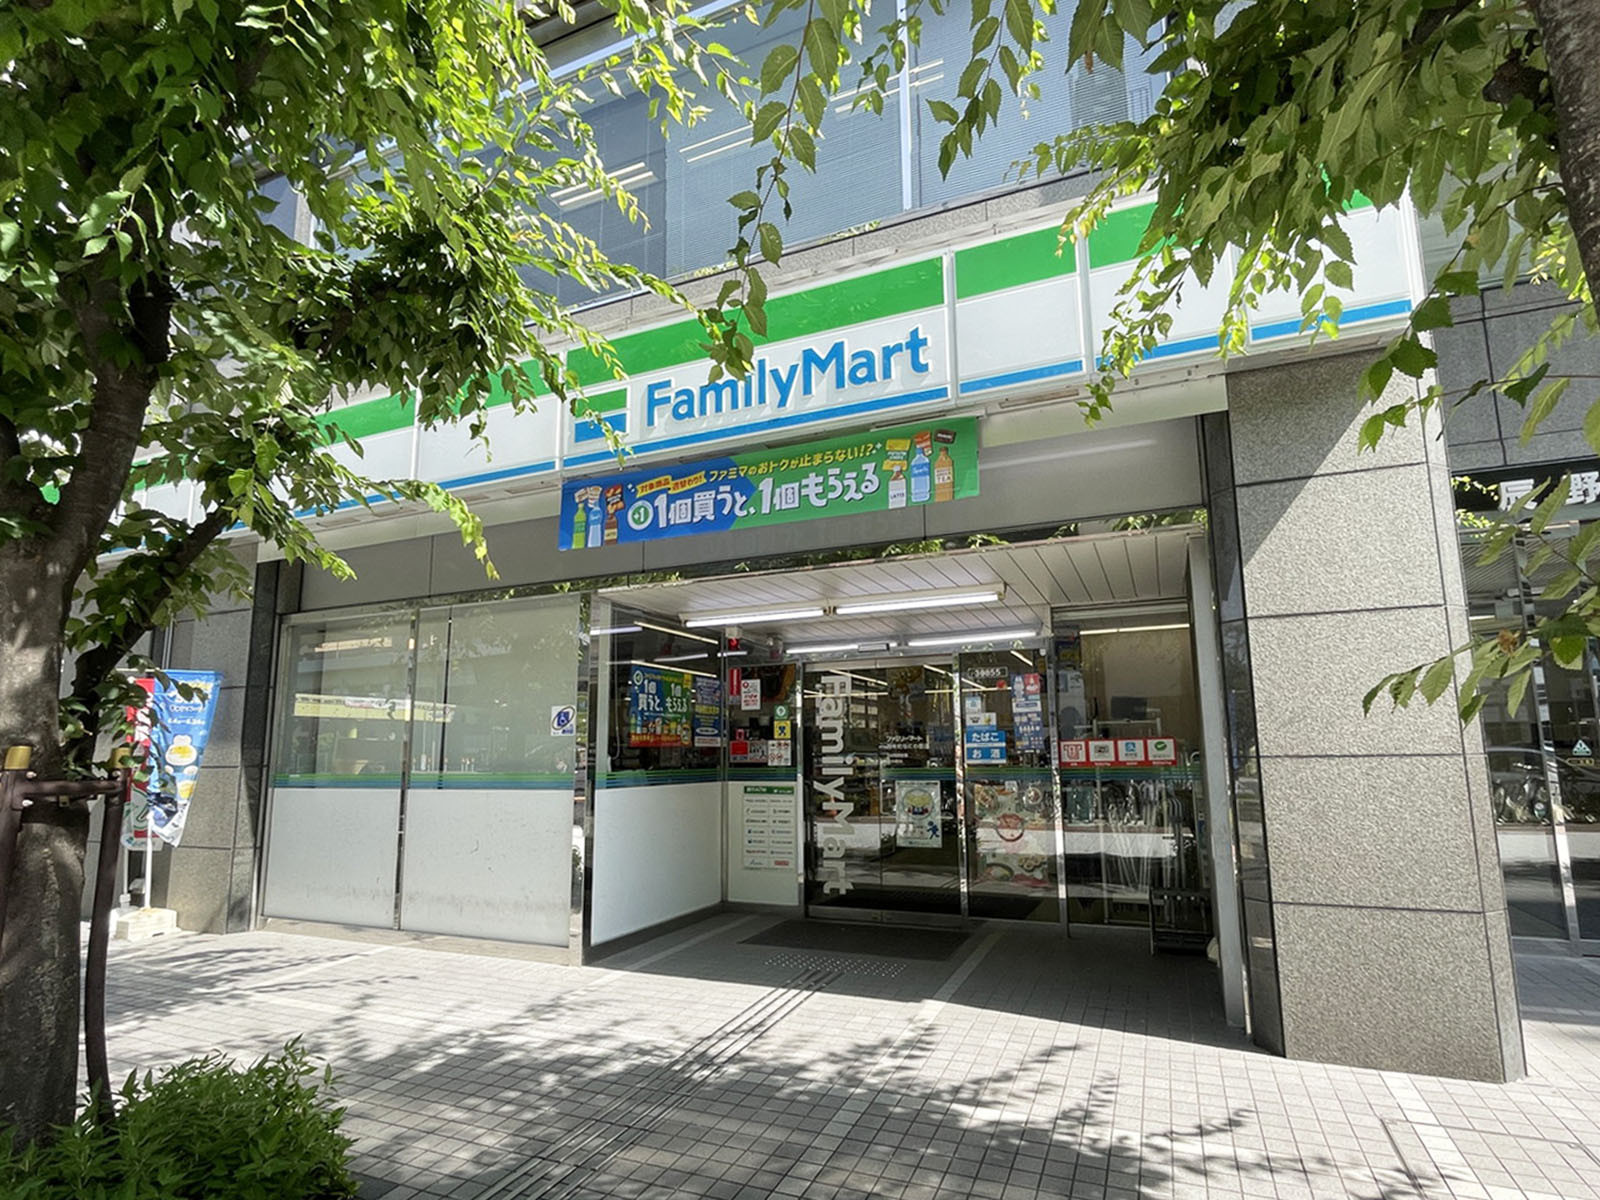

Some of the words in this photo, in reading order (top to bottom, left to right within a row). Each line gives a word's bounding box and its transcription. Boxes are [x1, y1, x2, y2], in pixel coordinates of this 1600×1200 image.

[646, 326, 929, 427] FamilyMart
[813, 675, 855, 895] FamilyMart
[971, 732, 1000, 742] たばこ
